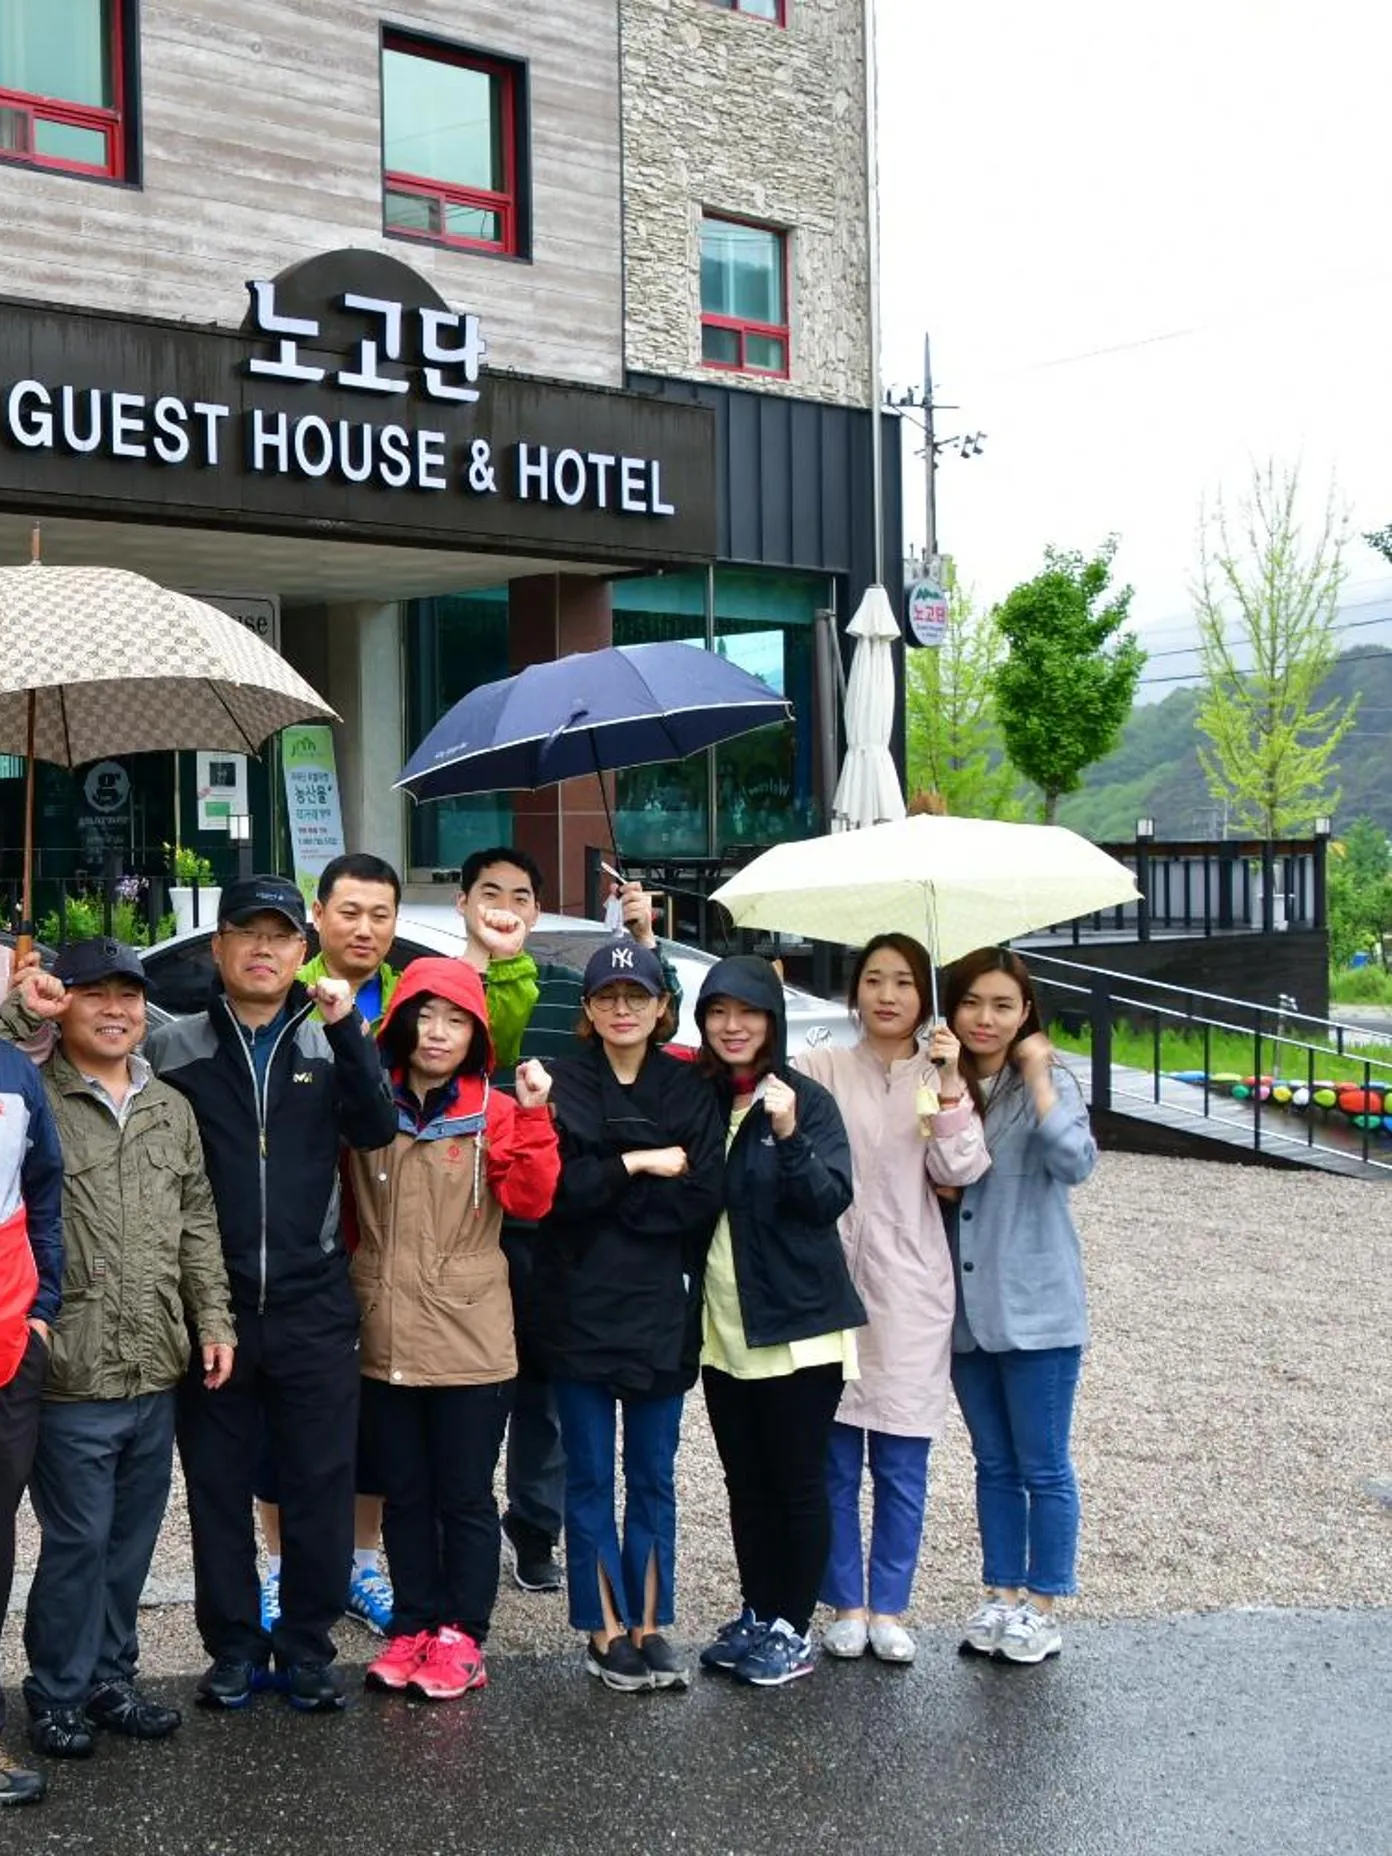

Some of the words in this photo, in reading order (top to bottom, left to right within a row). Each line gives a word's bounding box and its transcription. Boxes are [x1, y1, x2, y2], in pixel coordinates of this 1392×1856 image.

[248, 281, 486, 402] 노고단
[8, 379, 230, 465] GUEST
[252, 409, 447, 489] HOUSE
[468, 439, 498, 492] &
[519, 442, 675, 515] HOTEL
[612, 947, 634, 968] NY
